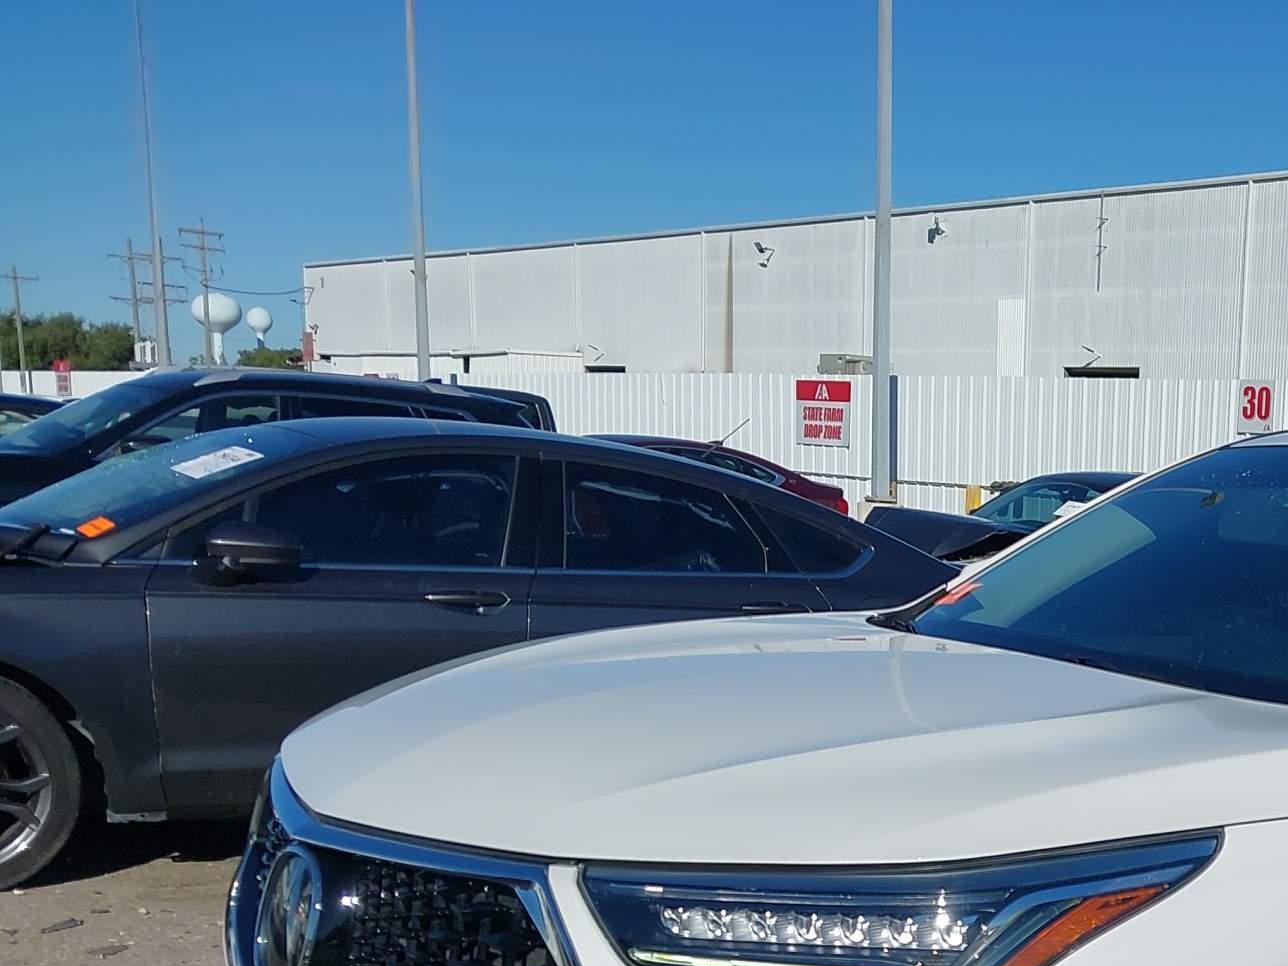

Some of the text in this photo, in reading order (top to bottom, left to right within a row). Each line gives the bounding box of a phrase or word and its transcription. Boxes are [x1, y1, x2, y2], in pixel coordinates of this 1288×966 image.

[1242, 386, 1271, 420] 30
[803, 406, 844, 422] STATE FARM
[804, 423, 842, 440] DROP ZONE
